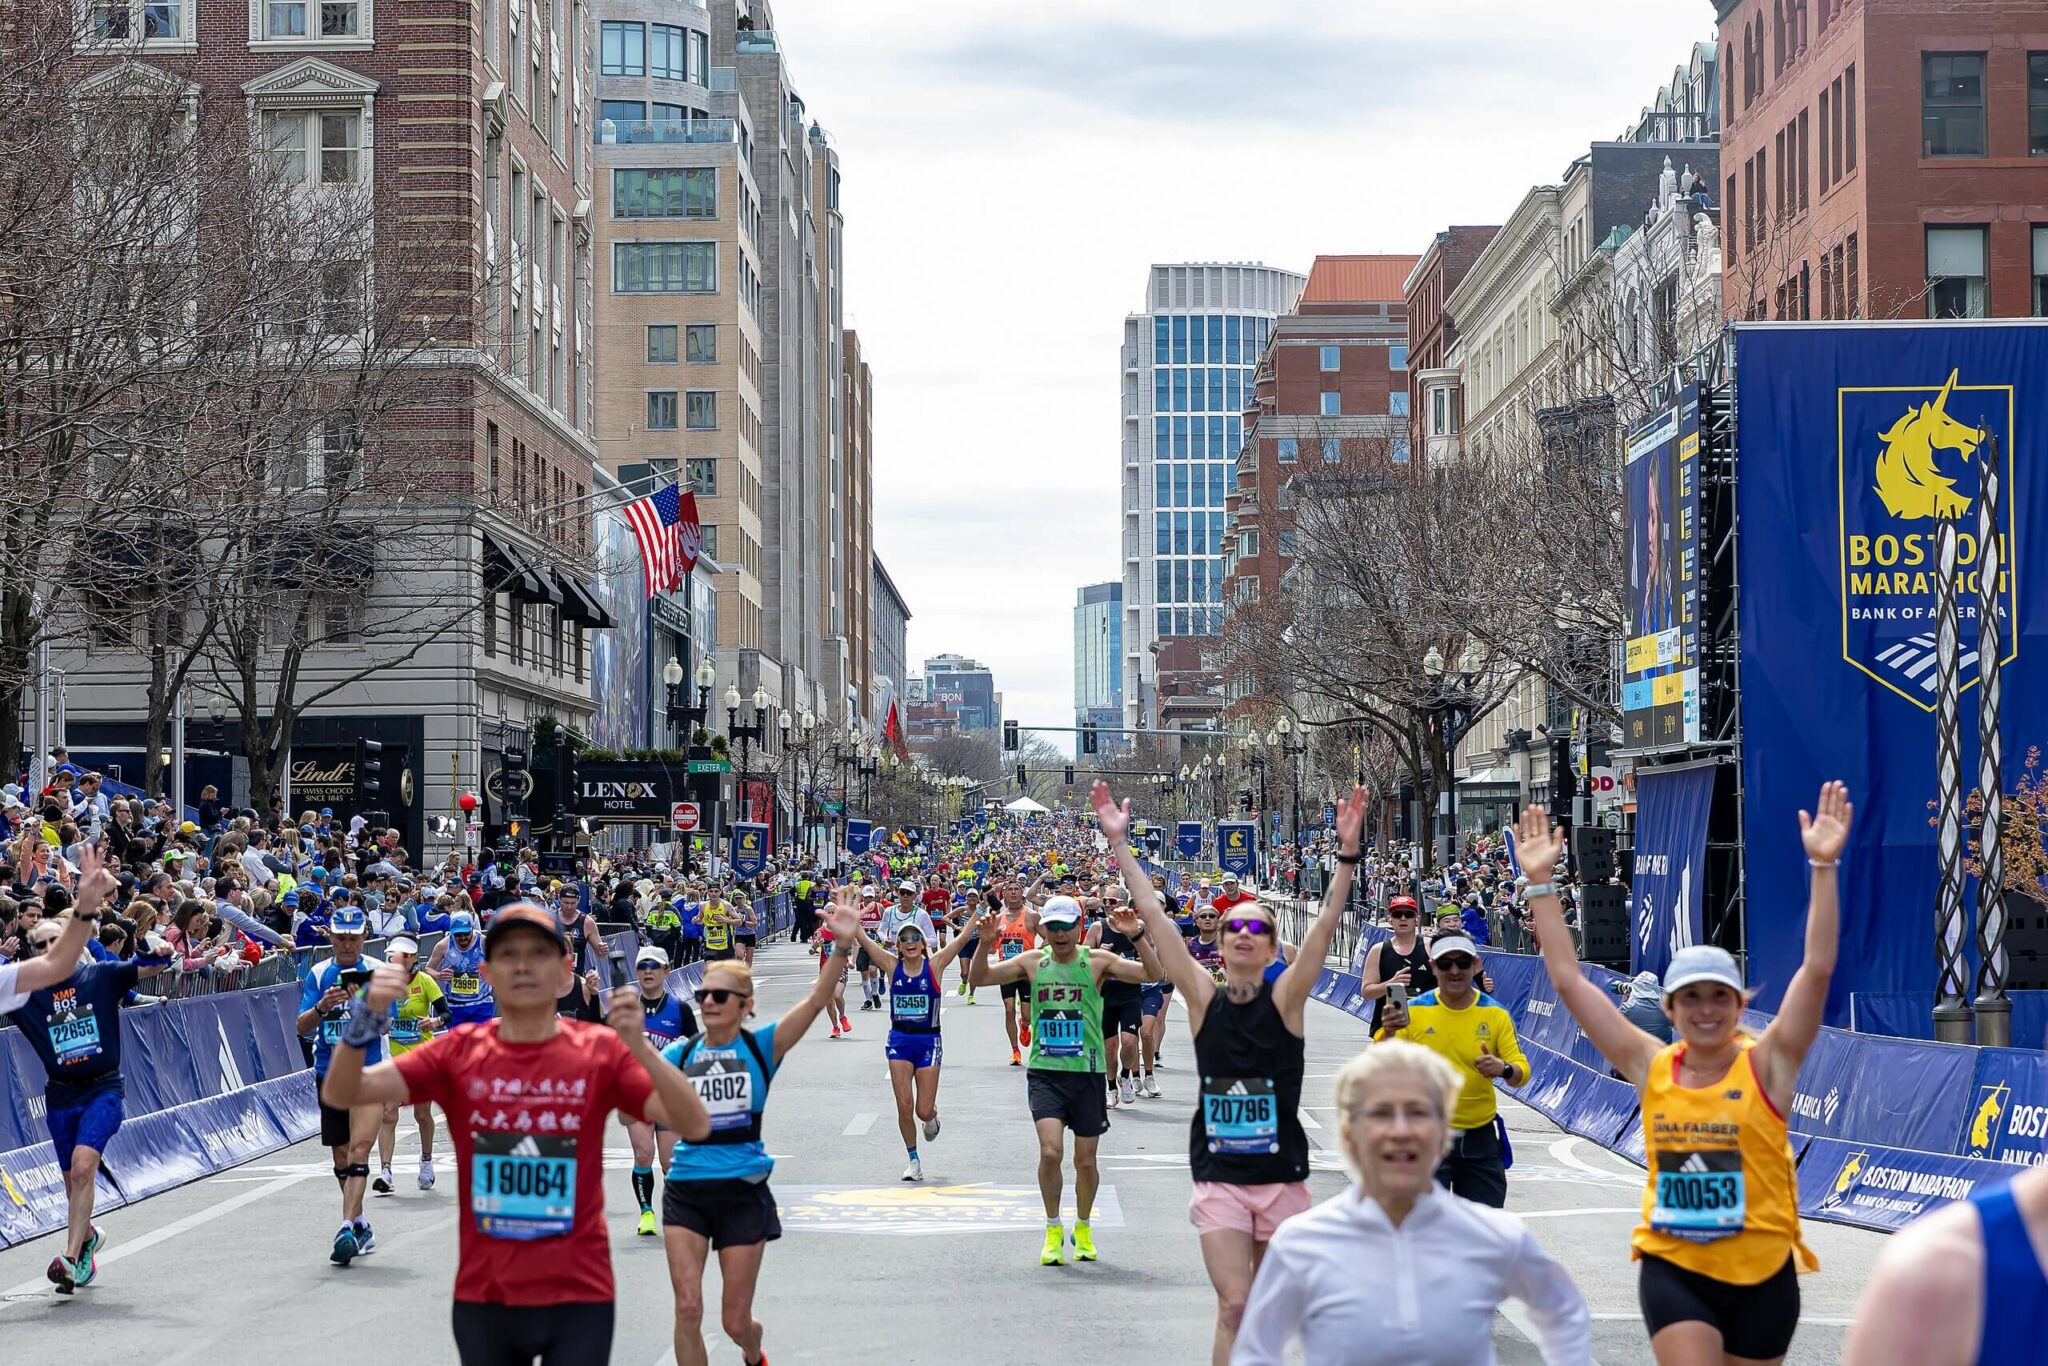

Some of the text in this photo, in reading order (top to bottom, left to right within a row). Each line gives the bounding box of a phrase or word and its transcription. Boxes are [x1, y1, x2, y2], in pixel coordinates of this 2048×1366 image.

[1850, 533, 2005, 566] BOSO
[1852, 606, 2007, 619] BANK OF AERA
[290, 760, 350, 782] Lindt
[697, 763, 721, 772] EXETER
[302, 787, 327, 795] SWISS
[325, 787, 354, 795] CHOCO
[604, 800, 636, 810] HOTEL
[53, 987, 76, 1001] XMP
[54, 996, 77, 1012] BOS
[896, 995, 926, 1009] 25459
[53, 1018, 95, 1045] 22655
[1042, 1021, 1079, 1038] 19111
[1210, 1097, 1270, 1124] 20796
[1791, 1091, 1822, 1121] AMERICA
[483, 1159, 567, 1198] 19064
[1861, 1165, 1976, 1201] BOSTON MARATHON
[1661, 1175, 1738, 1211] 20053
[1852, 1193, 1924, 1215] BANK OF AMERICA
